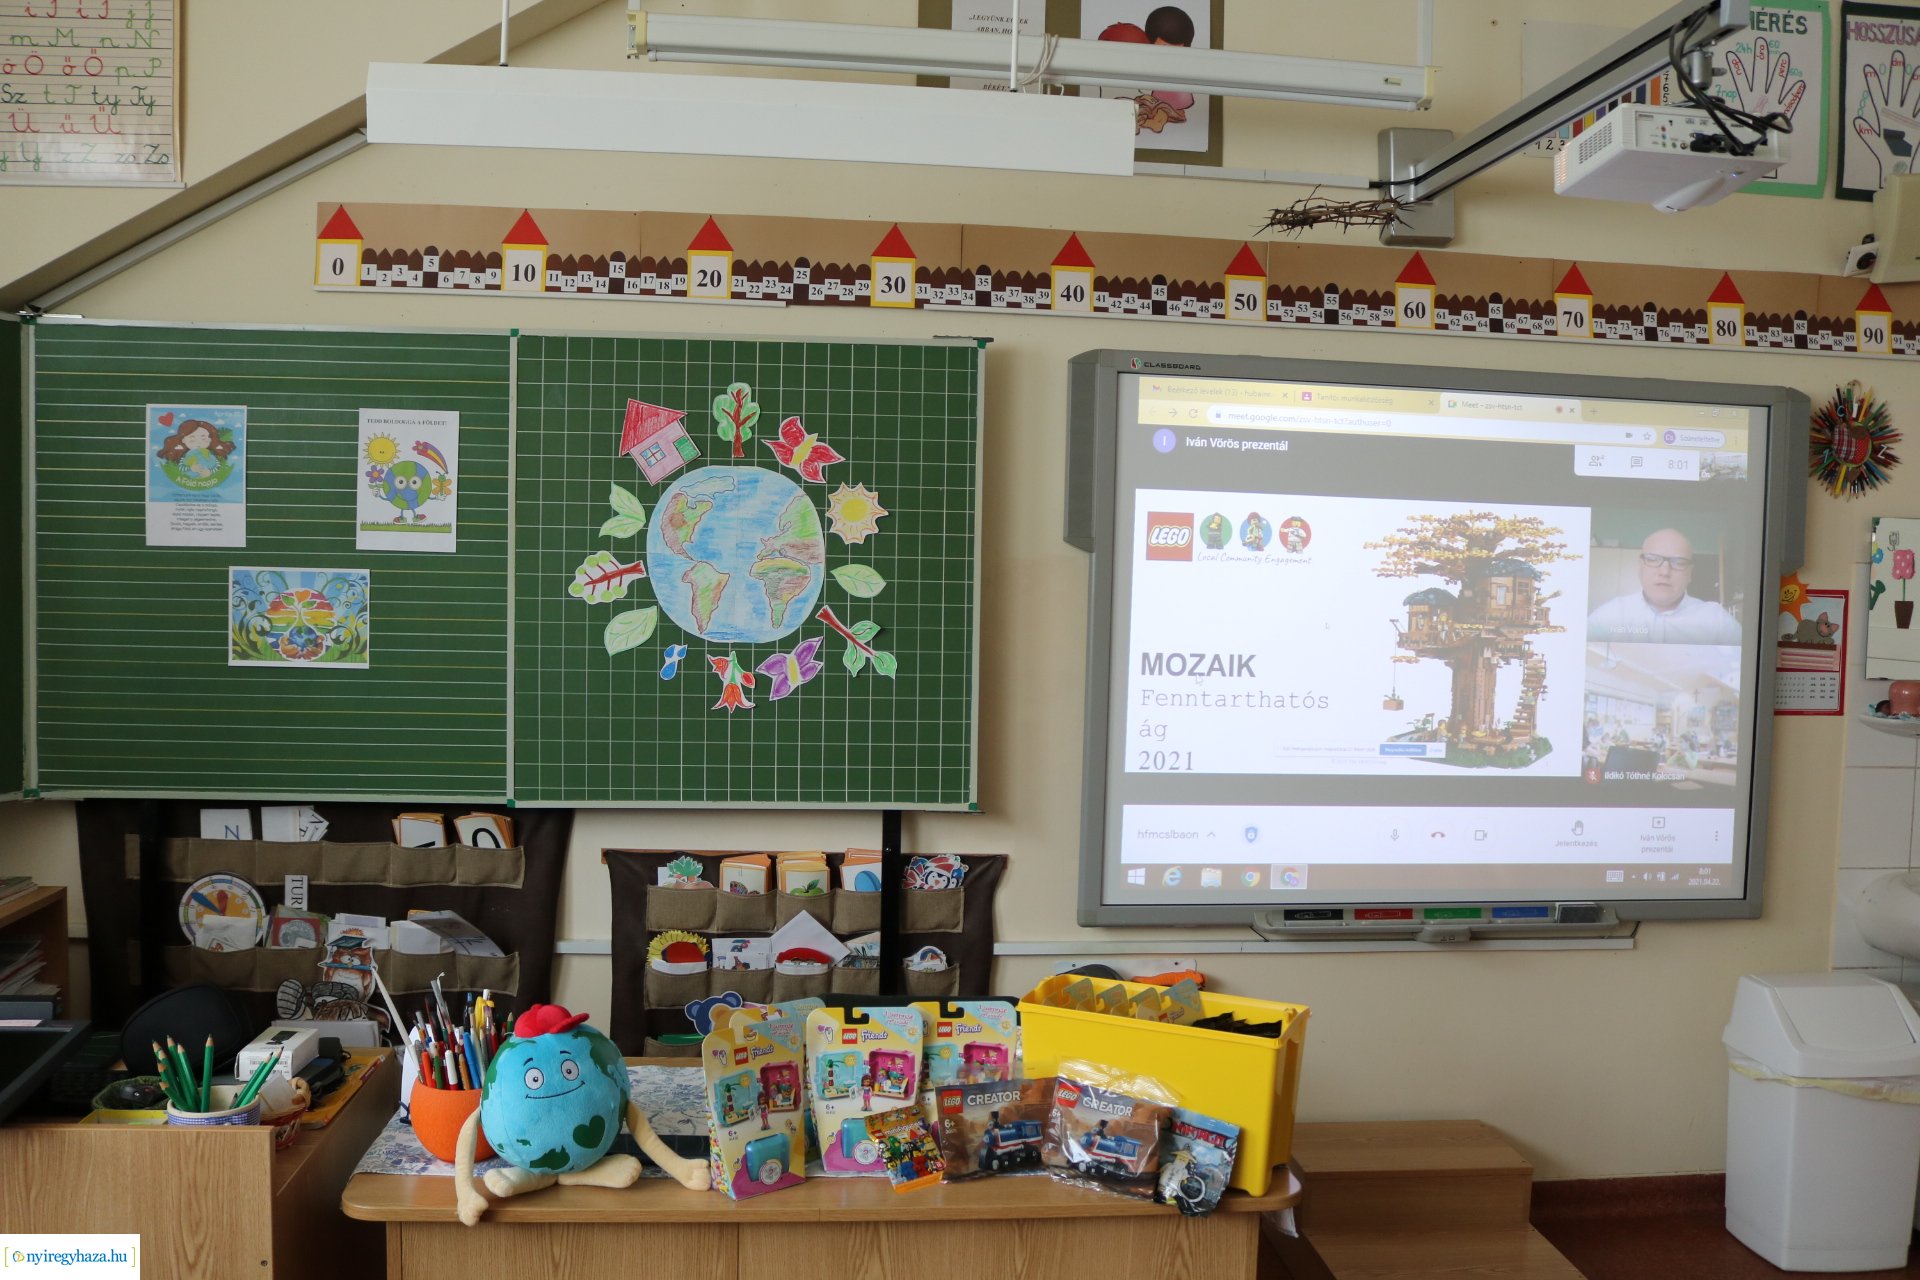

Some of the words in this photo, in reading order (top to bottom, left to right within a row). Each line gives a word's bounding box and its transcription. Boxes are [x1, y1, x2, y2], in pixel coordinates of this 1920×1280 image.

[1750, 8, 1808, 34] ÉRÉS
[331, 257, 345, 276] 0
[366, 267, 371, 276] 1
[381, 273, 388, 282] 2
[397, 267, 403, 277] 3
[412, 273, 419, 282] 4
[428, 258, 435, 268] 5
[443, 274, 450, 284] 6
[459, 270, 465, 280] 7
[474, 275, 481, 285] 8
[491, 271, 497, 280] 9
[511, 263, 536, 283] 10
[548, 273, 559, 282] 11
[564, 278, 576, 288] 12
[580, 273, 592, 283] 13
[595, 279, 607, 289] 14
[612, 264, 624, 274] 15
[626, 280, 638, 290] 16
[643, 275, 654, 285] 17
[658, 281, 670, 290] 18
[674, 276, 686, 286] 19
[696, 269, 722, 288] 20
[734, 278, 745, 288] 21
[748, 285, 760, 294] 22
[765, 279, 777, 289] 23
[780, 285, 792, 295] 24
[796, 270, 808, 279] 25
[811, 286, 823, 296] 26
[827, 281, 839, 290] 27
[842, 287, 854, 297] 28
[857, 282, 870, 291] 29
[880, 275, 906, 294] 30
[917, 285, 928, 295] 31
[932, 290, 944, 299] 32
[947, 286, 959, 296] 33
[962, 292, 974, 301] 34
[977, 277, 989, 287] 35
[993, 294, 1005, 303] 36
[1008, 288, 1020, 298] 37
[1023, 295, 1035, 304] 38
[1038, 290, 1050, 300] 39
[1060, 284, 1085, 303] 40
[1095, 294, 1107, 303] 41
[1110, 300, 1122, 309] 42
[1124, 296, 1136, 305] 43
[1139, 302, 1151, 311] 44
[1153, 287, 1165, 297] 45
[1169, 303, 1181, 312] 46
[1183, 299, 1195, 308] 47
[1198, 305, 1210, 314] 48
[1212, 301, 1224, 310] 49
[1234, 292, 1258, 312] 50
[1269, 302, 1279, 312] 51
[1283, 308, 1294, 318] 52
[1297, 304, 1309, 313] 53
[1312, 310, 1323, 319] 54
[1326, 296, 1338, 306] 55
[1340, 312, 1352, 321] 56
[1354, 306, 1366, 316] 57
[1369, 312, 1380, 322] 58
[1383, 308, 1394, 317] 59
[1403, 300, 1426, 320] 60
[1436, 311, 1446, 320] 61
[1450, 318, 1461, 327] 62
[1463, 313, 1474, 322] 63
[1477, 319, 1489, 329] 64
[1490, 306, 1501, 315] 65
[1505, 321, 1516, 330] 66
[1518, 316, 1529, 325] 67
[1532, 321, 1543, 330] 68
[1544, 317, 1555, 327] 69
[1562, 310, 1585, 329] 70
[1593, 320, 1603, 329] 71
[1607, 326, 1618, 335] 72
[1620, 322, 1630, 331] 73
[1633, 328, 1644, 337] 74
[1645, 314, 1656, 323] 75
[1659, 329, 1670, 338] 76
[1671, 325, 1682, 334] 77
[1685, 330, 1695, 339] 78
[1697, 326, 1707, 335] 79
[1716, 319, 1737, 338] 80
[1745, 328, 1756, 337] 81
[1758, 334, 1769, 343] 82
[1770, 329, 1781, 338] 83
[1783, 335, 1793, 344] 84
[1795, 322, 1806, 331] 85
[1808, 336, 1819, 345] 86
[1820, 331, 1830, 340] 87
[1833, 338, 1843, 347] 88
[1844, 333, 1855, 343] 89
[1863, 327, 1884, 345] 90
[1893, 336, 1903, 345] 91
[1905, 342, 1916, 351] 92
[1144, 362, 1201, 370] CLASSBOARD
[1186, 436, 1207, 448] Iván
[1210, 438, 1240, 449] Vörös
[1242, 440, 1288, 452] prezentál
[1149, 526, 1192, 546] LEGO
[1141, 652, 1256, 678] MOZAIK
[1140, 689, 1329, 709] Fenntarthatós
[1139, 720, 1168, 742] ág
[1139, 751, 1194, 770] 2021
[944, 1096, 961, 1105] LEGO
[967, 1090, 1021, 1105] CREATOR
[1058, 1087, 1078, 1101] LEGO
[1082, 1096, 1133, 1116] CREATOR
